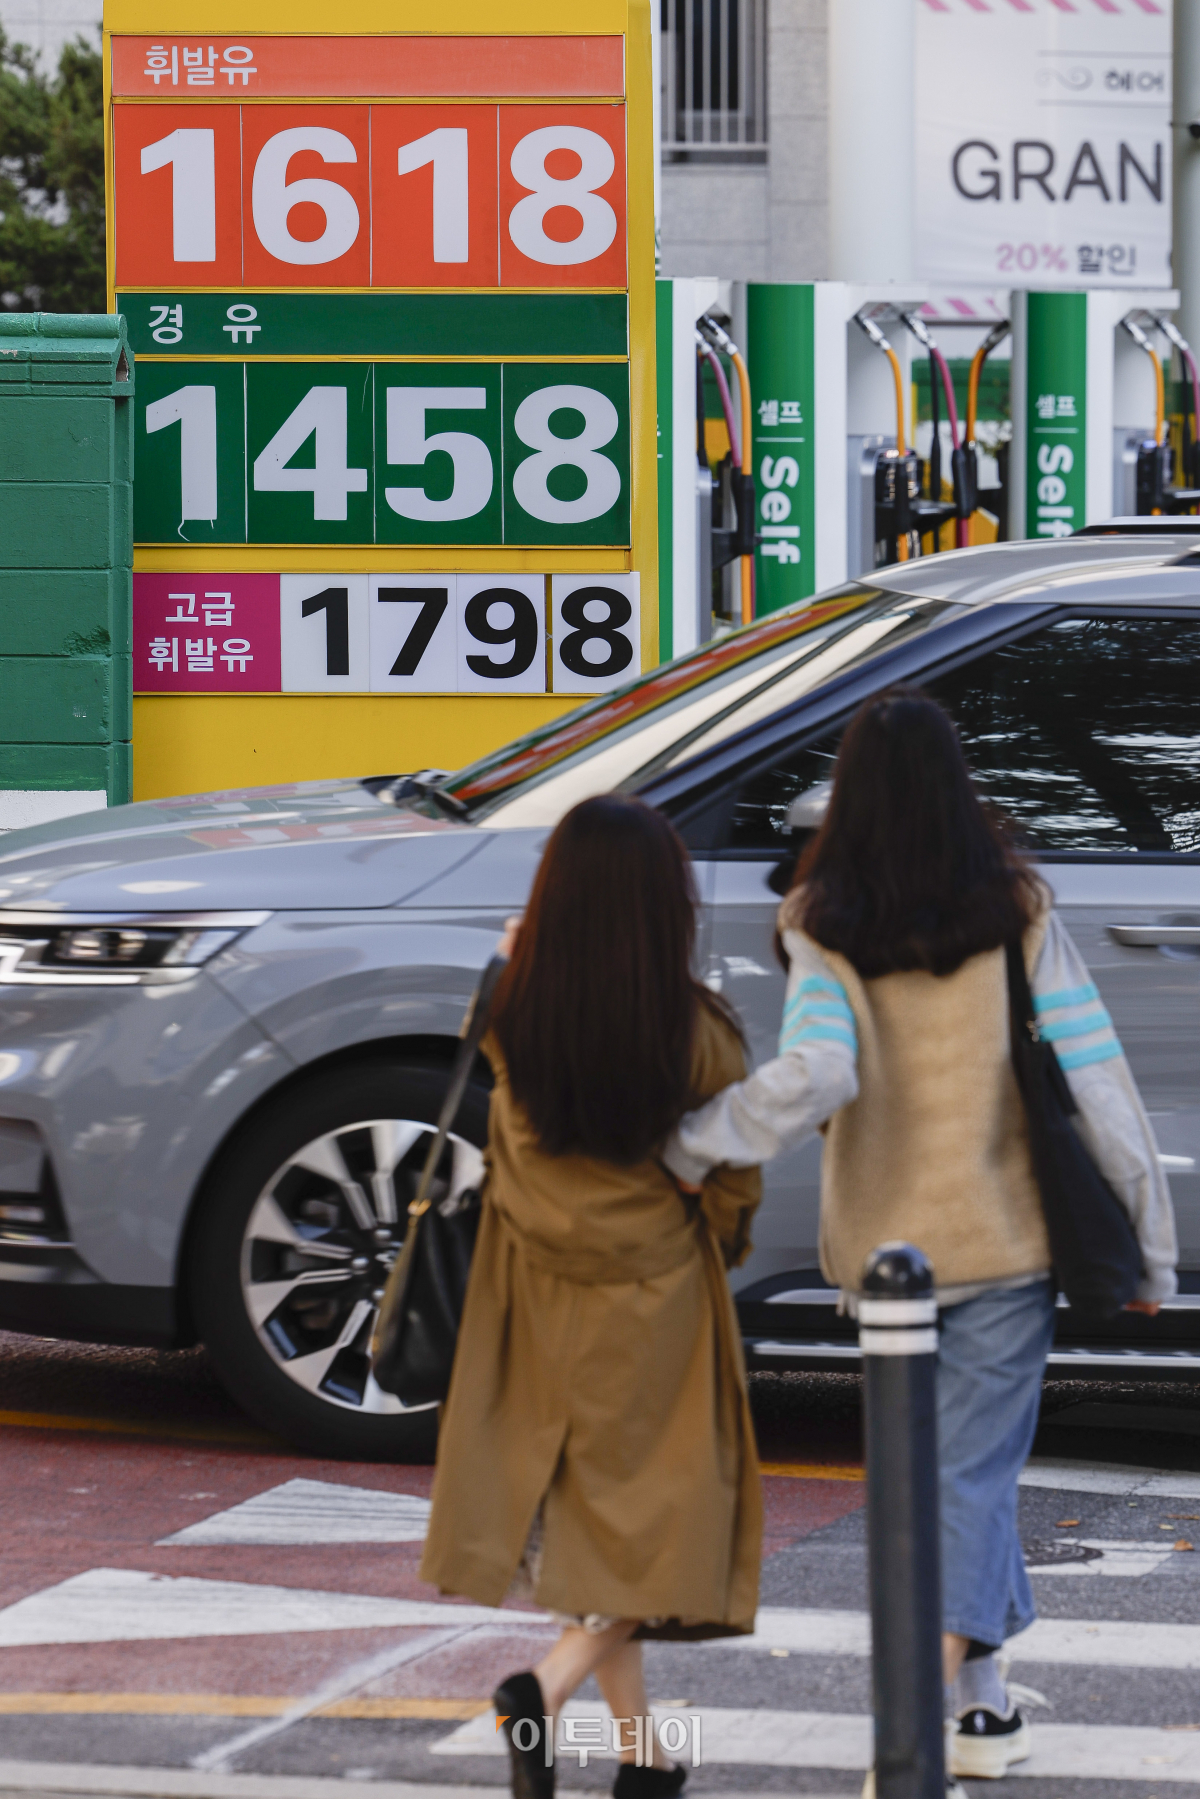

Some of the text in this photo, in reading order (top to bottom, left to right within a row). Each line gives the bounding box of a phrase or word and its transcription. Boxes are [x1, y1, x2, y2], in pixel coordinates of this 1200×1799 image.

[143, 45, 258, 86] 휘발유
[140, 125, 618, 266] 1618
[952, 140, 1164, 202] GRAN
[997, 243, 1137, 275] 20% 할인
[757, 399, 804, 427] 셀프
[145, 384, 622, 524] 1458
[760, 454, 801, 564] Self
[1037, 443, 1074, 538] Self
[165, 591, 236, 627] 고급
[301, 586, 634, 679] 1798
[147, 637, 255, 673] 휘발유
